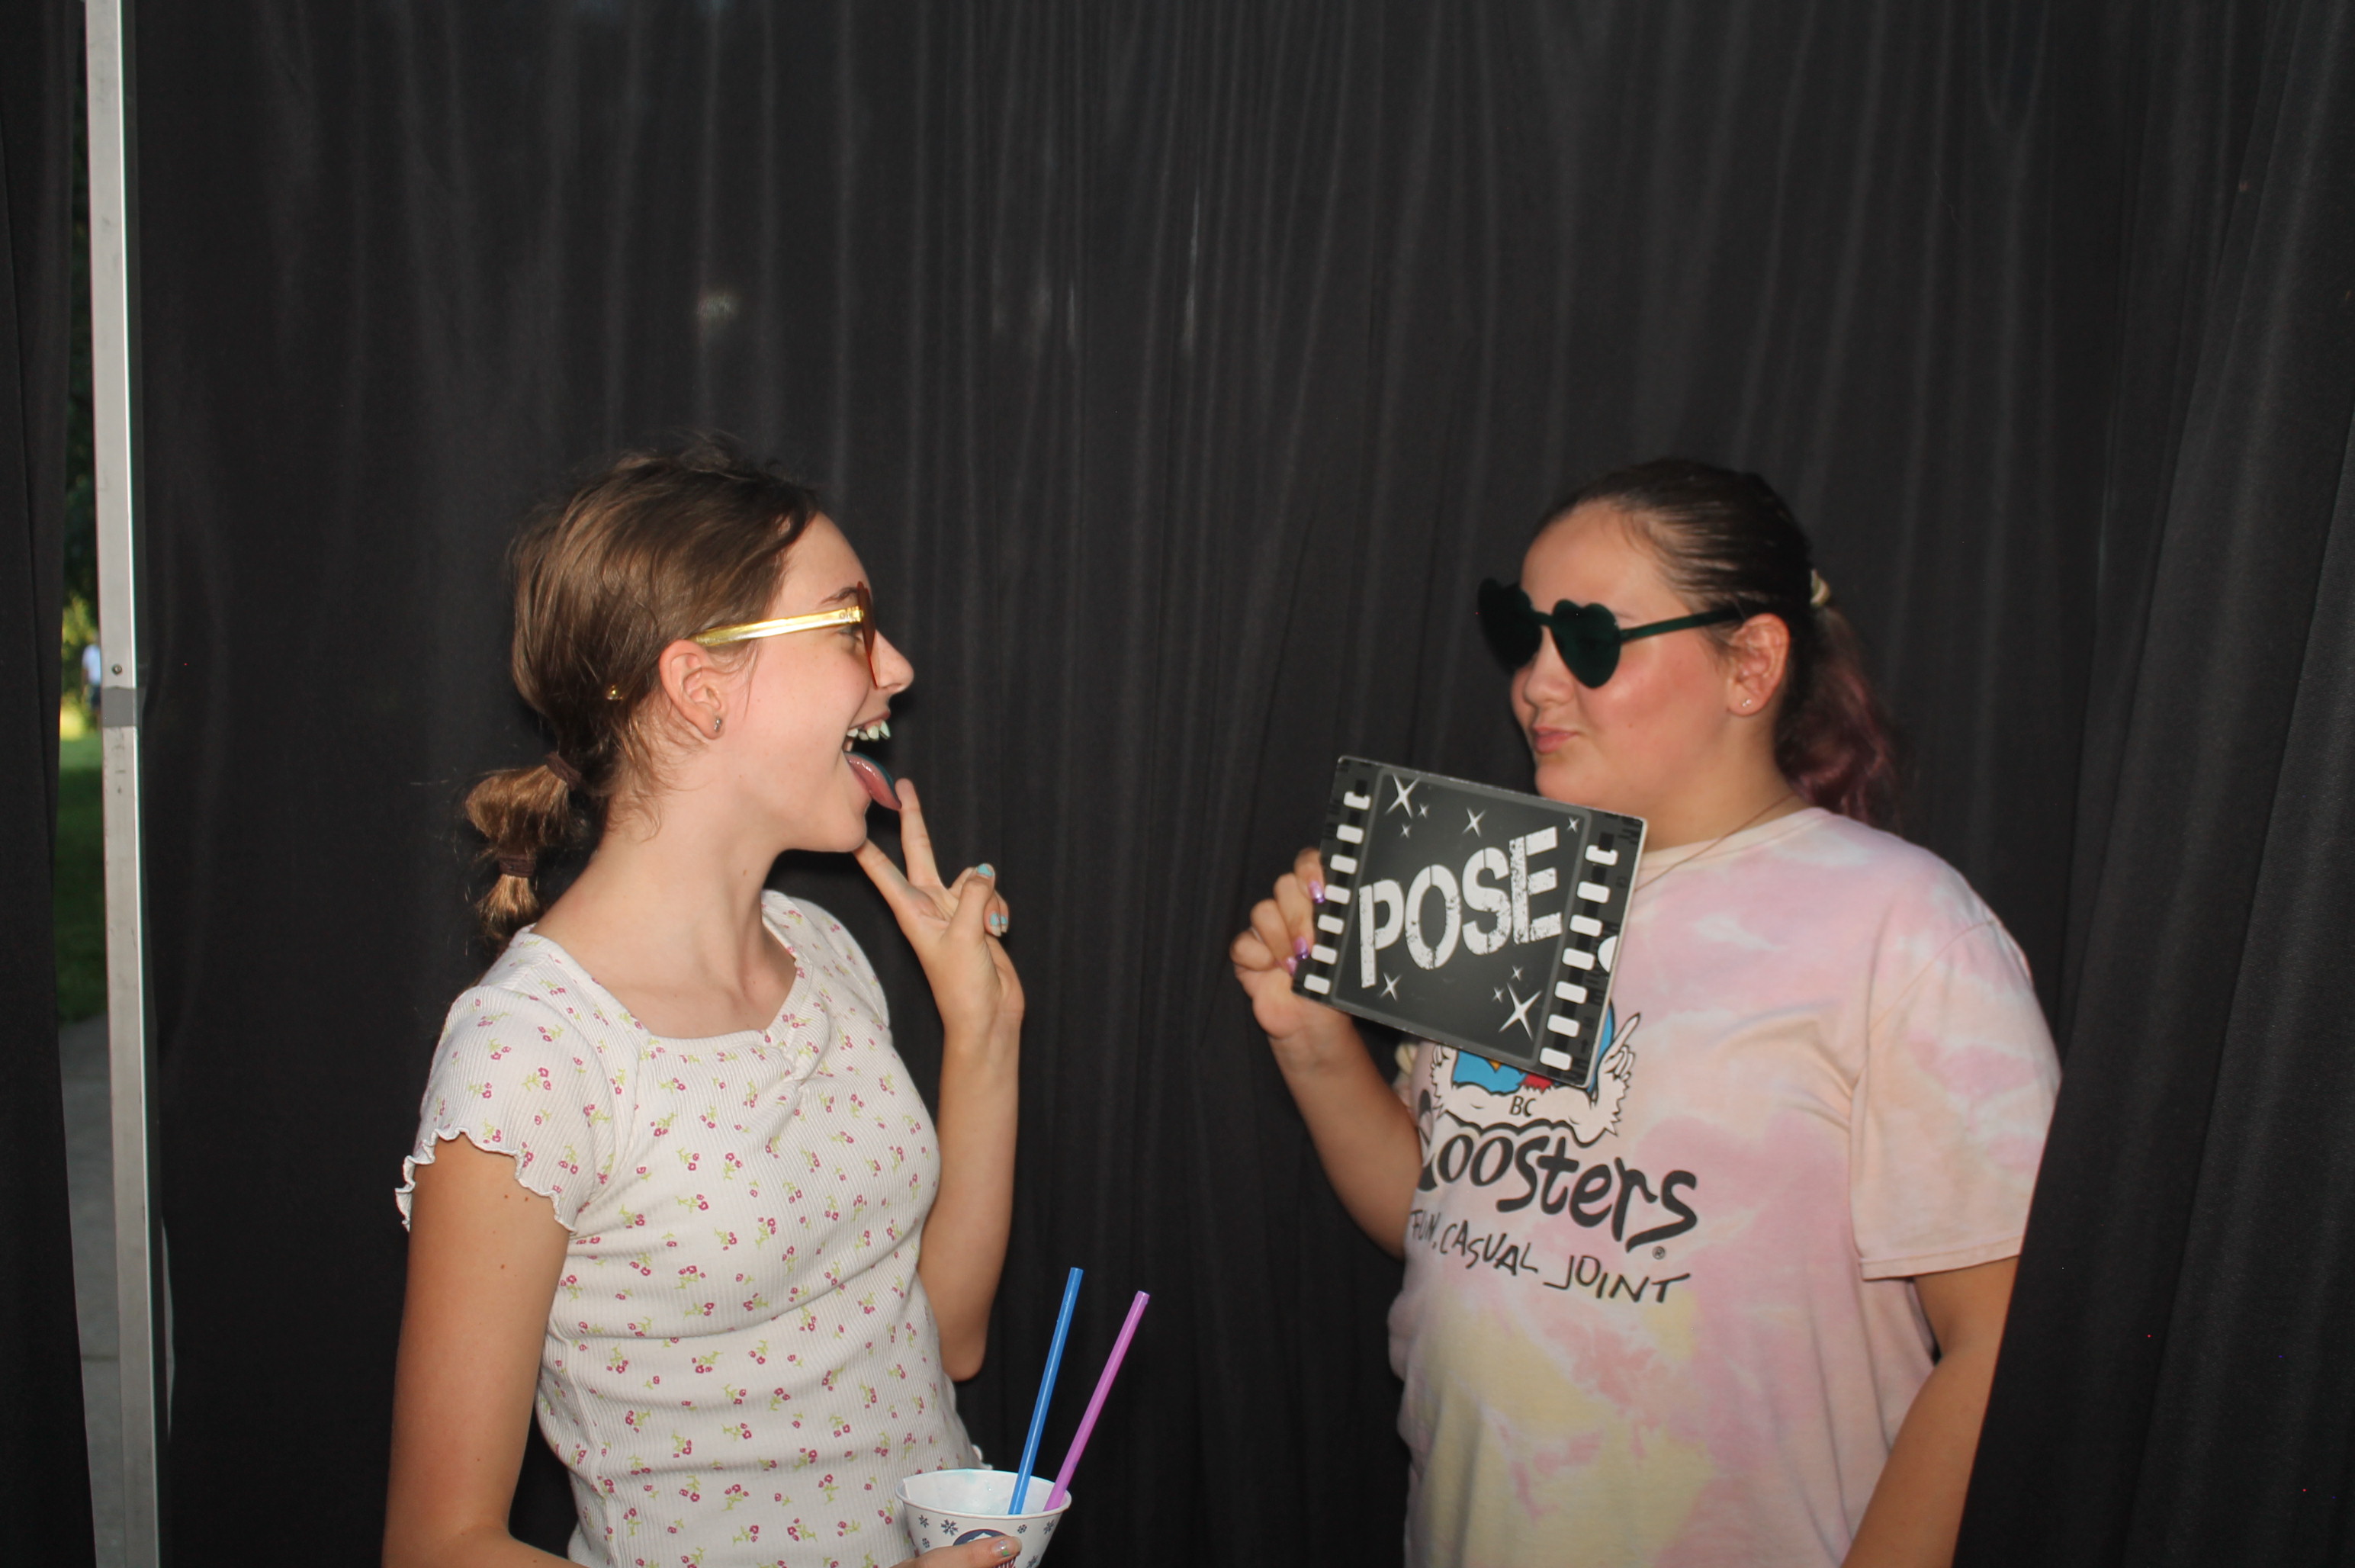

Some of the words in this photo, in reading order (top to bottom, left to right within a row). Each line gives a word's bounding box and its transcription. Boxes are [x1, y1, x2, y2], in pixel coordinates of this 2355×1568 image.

[1358, 826, 1563, 989] POSE
[1509, 1095, 1537, 1117] BC
[1439, 1219, 1538, 1276] CASUAL
[1544, 1255, 1692, 1303] JOINT
